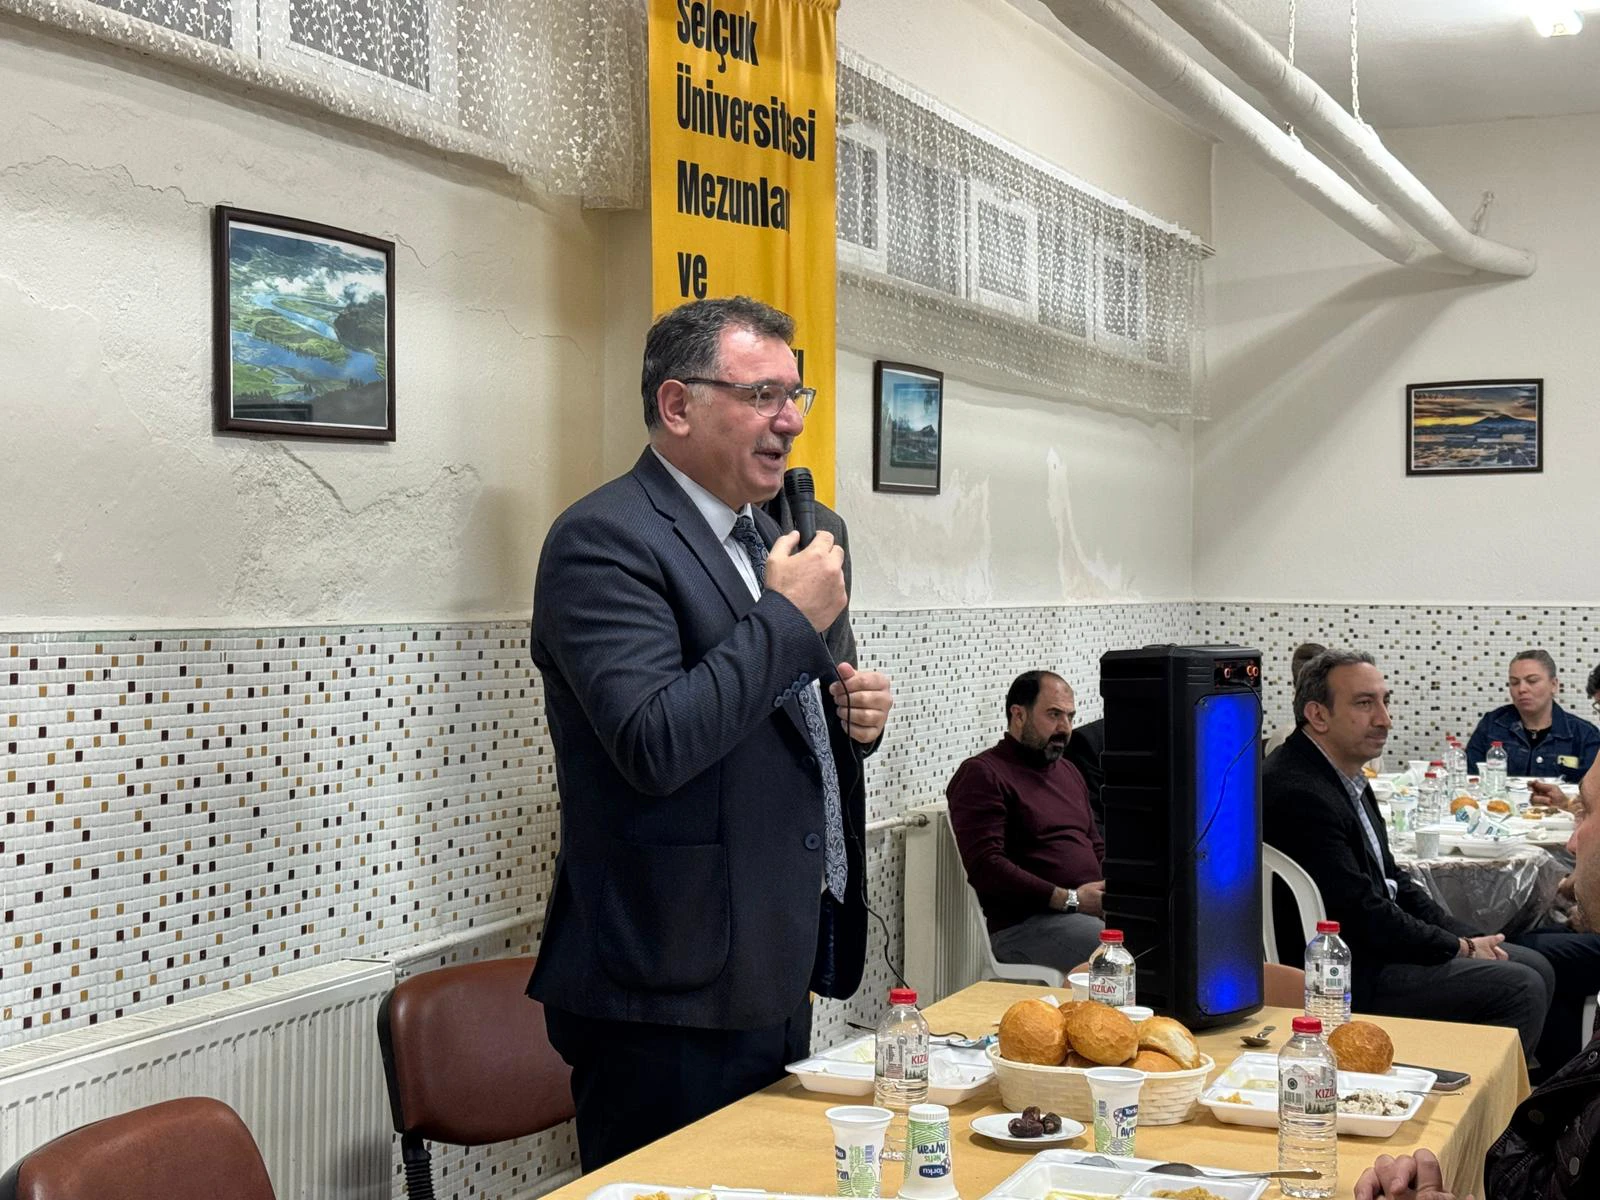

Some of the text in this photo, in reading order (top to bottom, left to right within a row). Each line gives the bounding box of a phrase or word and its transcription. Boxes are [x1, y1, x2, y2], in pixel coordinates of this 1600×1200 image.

[677, 0, 759, 73] Selçuk
[677, 62, 816, 161] Üniversitesi
[677, 252, 707, 299] ve
[917, 1141, 946, 1154] Ayran
[922, 1167, 945, 1176] Torku
